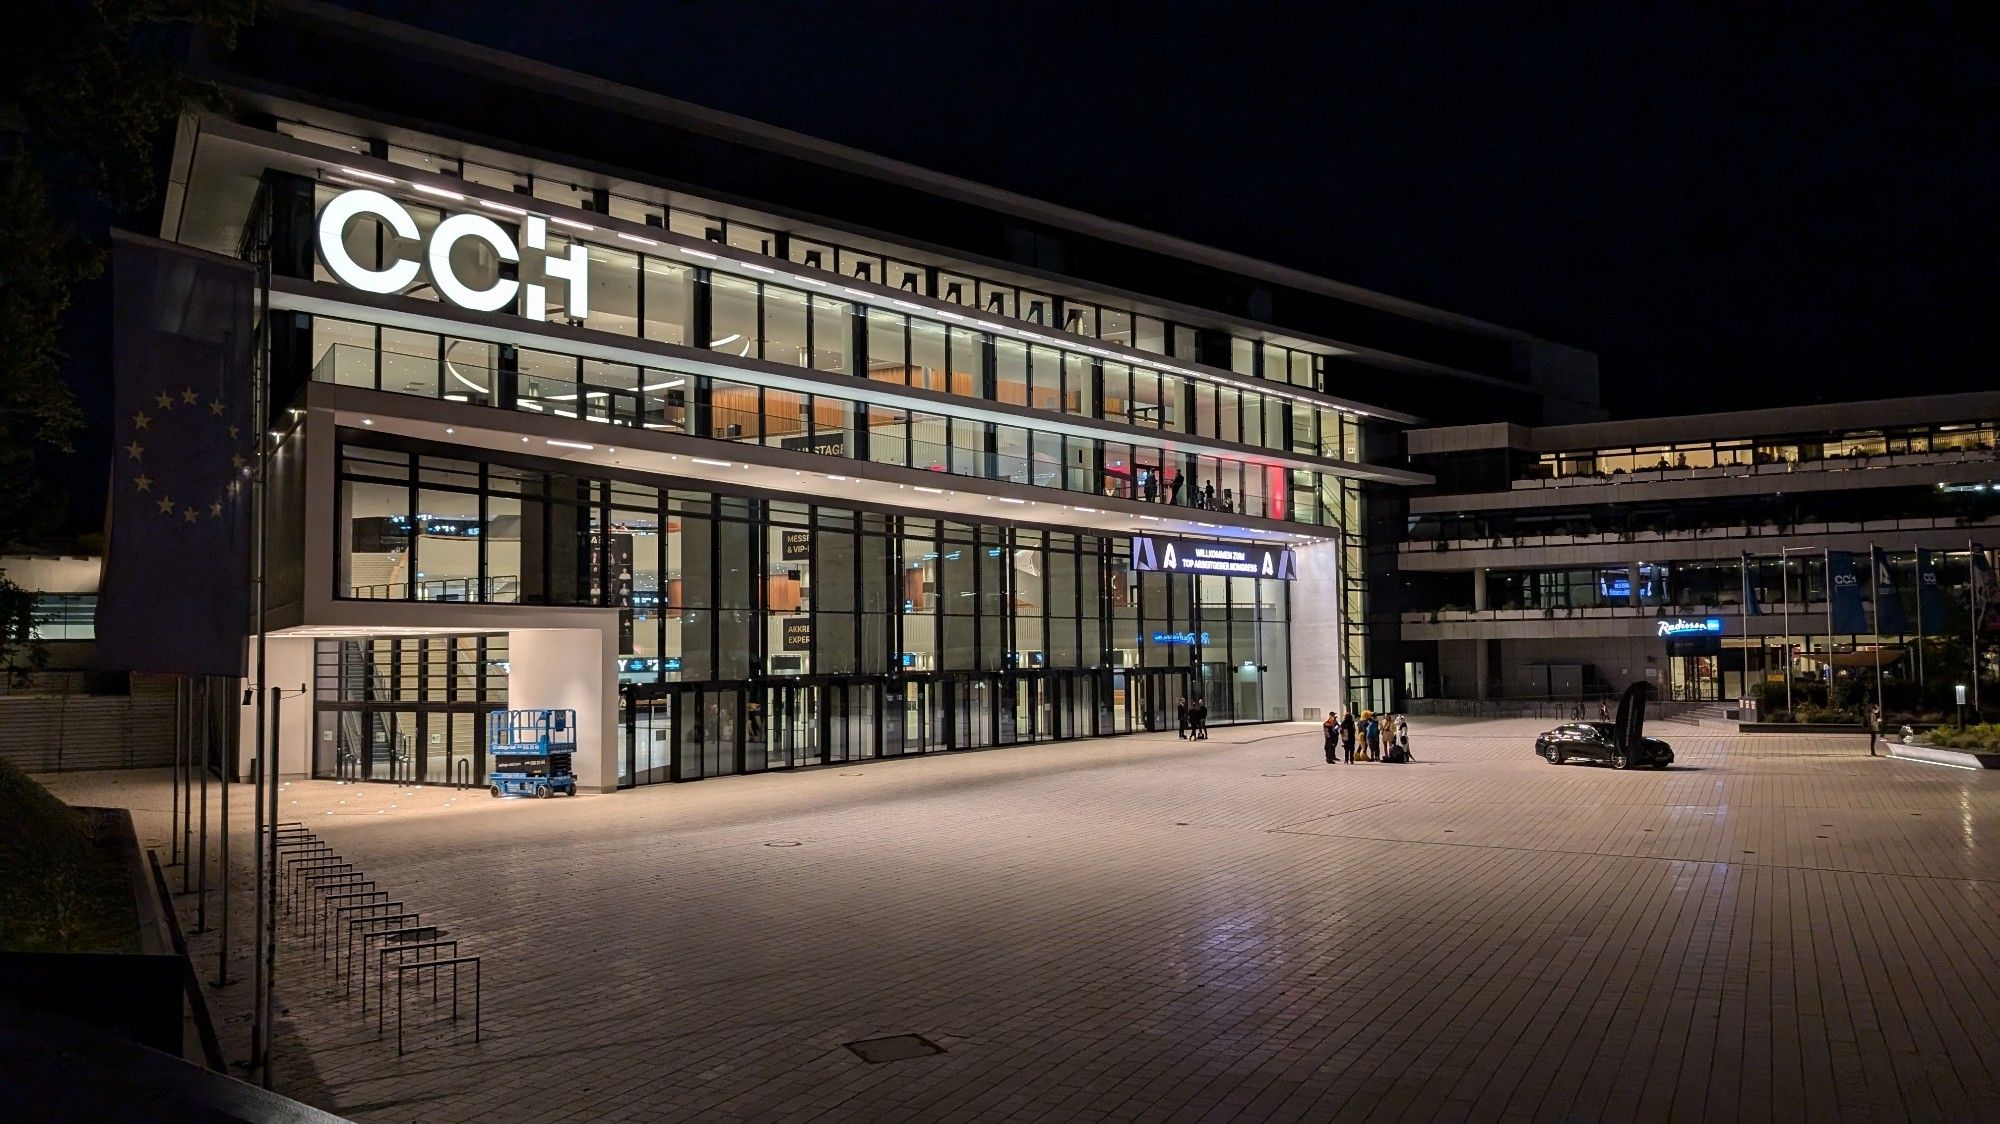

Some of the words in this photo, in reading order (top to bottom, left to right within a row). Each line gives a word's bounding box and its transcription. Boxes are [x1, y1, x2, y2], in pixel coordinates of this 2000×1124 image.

[318, 189, 588, 322] CCH
[1182, 558, 1194, 568] TOP
[1657, 618, 1707, 637] Radisson
